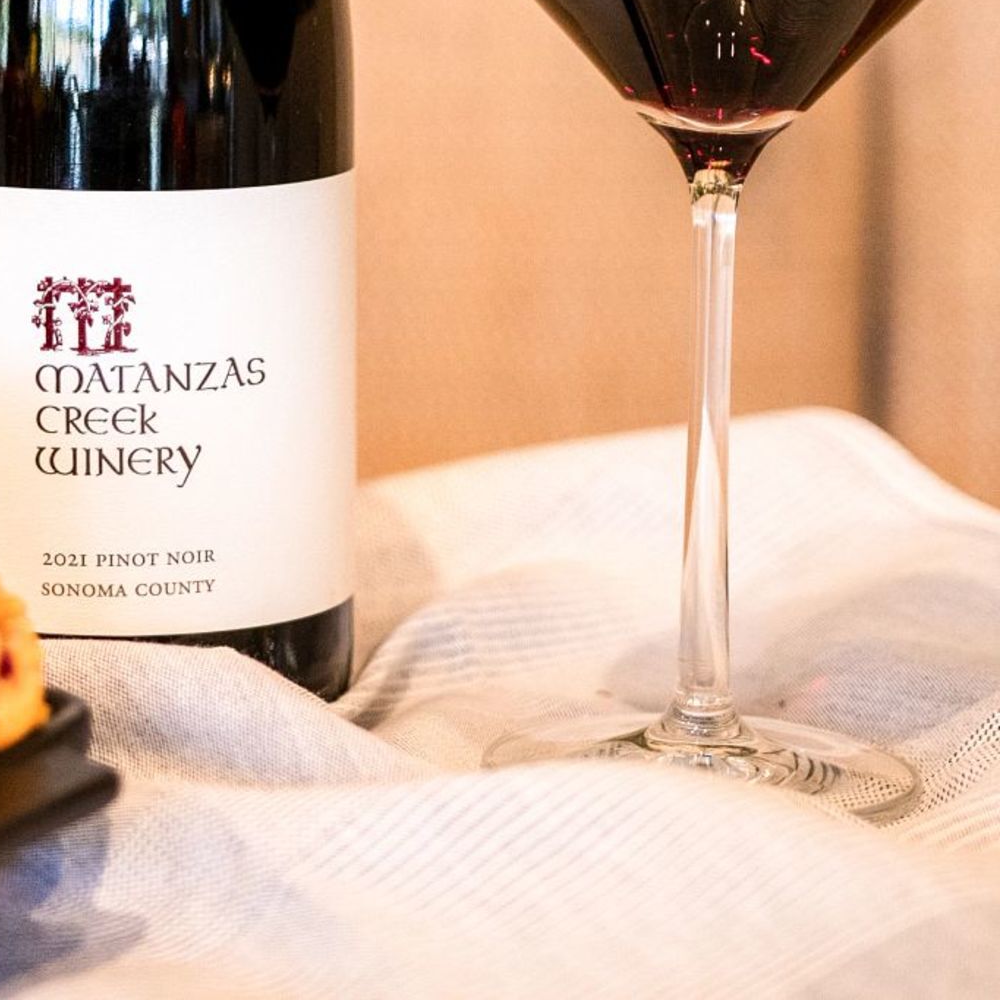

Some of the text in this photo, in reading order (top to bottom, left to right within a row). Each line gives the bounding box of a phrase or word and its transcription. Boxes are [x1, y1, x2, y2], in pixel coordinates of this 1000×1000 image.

[36, 357, 265, 394] MATANZAS
[43, 550, 215, 567] 2021 PINOT NOIR
[42, 579, 215, 597] SONOMA COUNTY
